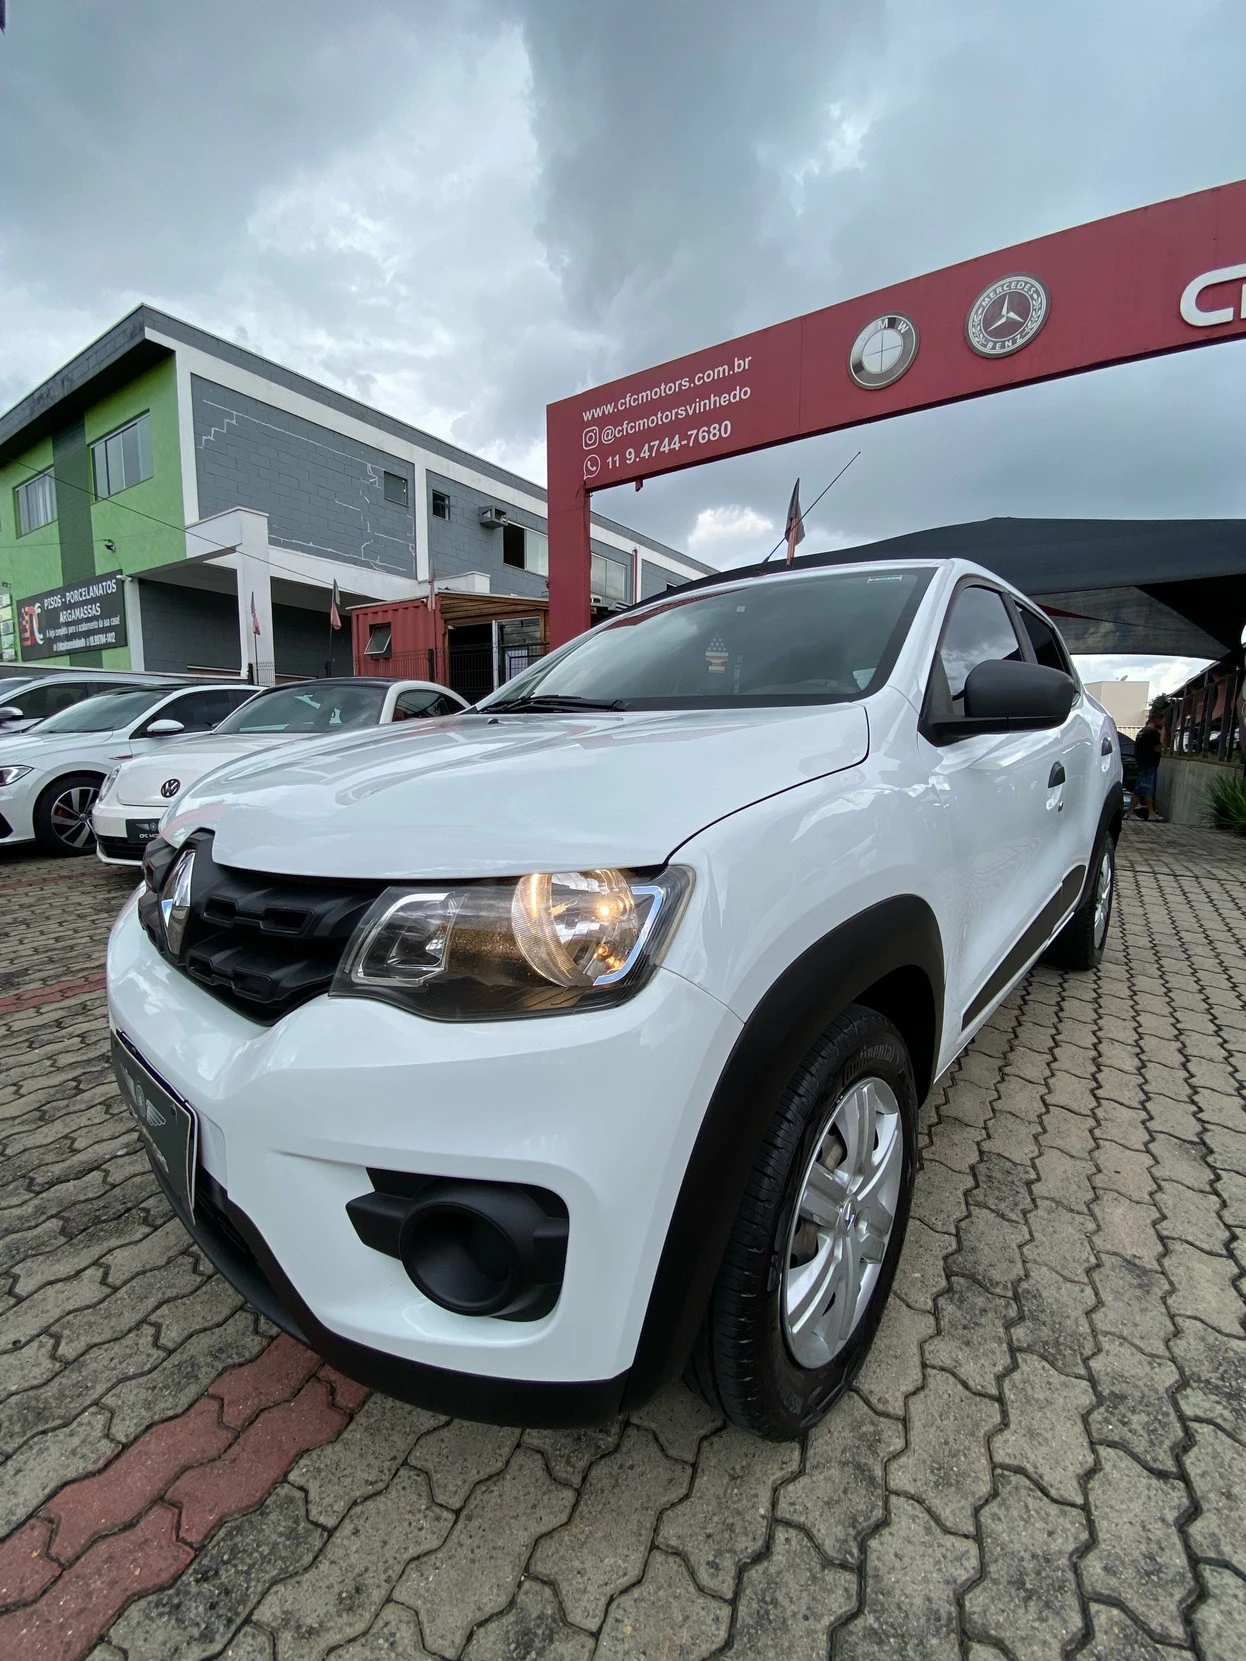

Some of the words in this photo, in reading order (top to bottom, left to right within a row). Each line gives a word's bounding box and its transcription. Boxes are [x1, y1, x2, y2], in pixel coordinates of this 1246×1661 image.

[981, 281, 1036, 307] MERCEDES
[1180, 263, 1246, 326] C
[986, 334, 1022, 350] BENZ
[582, 355, 752, 422] www.cfcmotors.com.br
[601, 386, 751, 444] @cfcmotorsvinhedo
[606, 454, 620, 469] 11
[625, 420, 732, 464] 9.4744-7680
[44, 596, 62, 610] PISOS
[66, 579, 117, 603] PORCELANATOS
[60, 603, 101, 623] ARGAMASSAS
